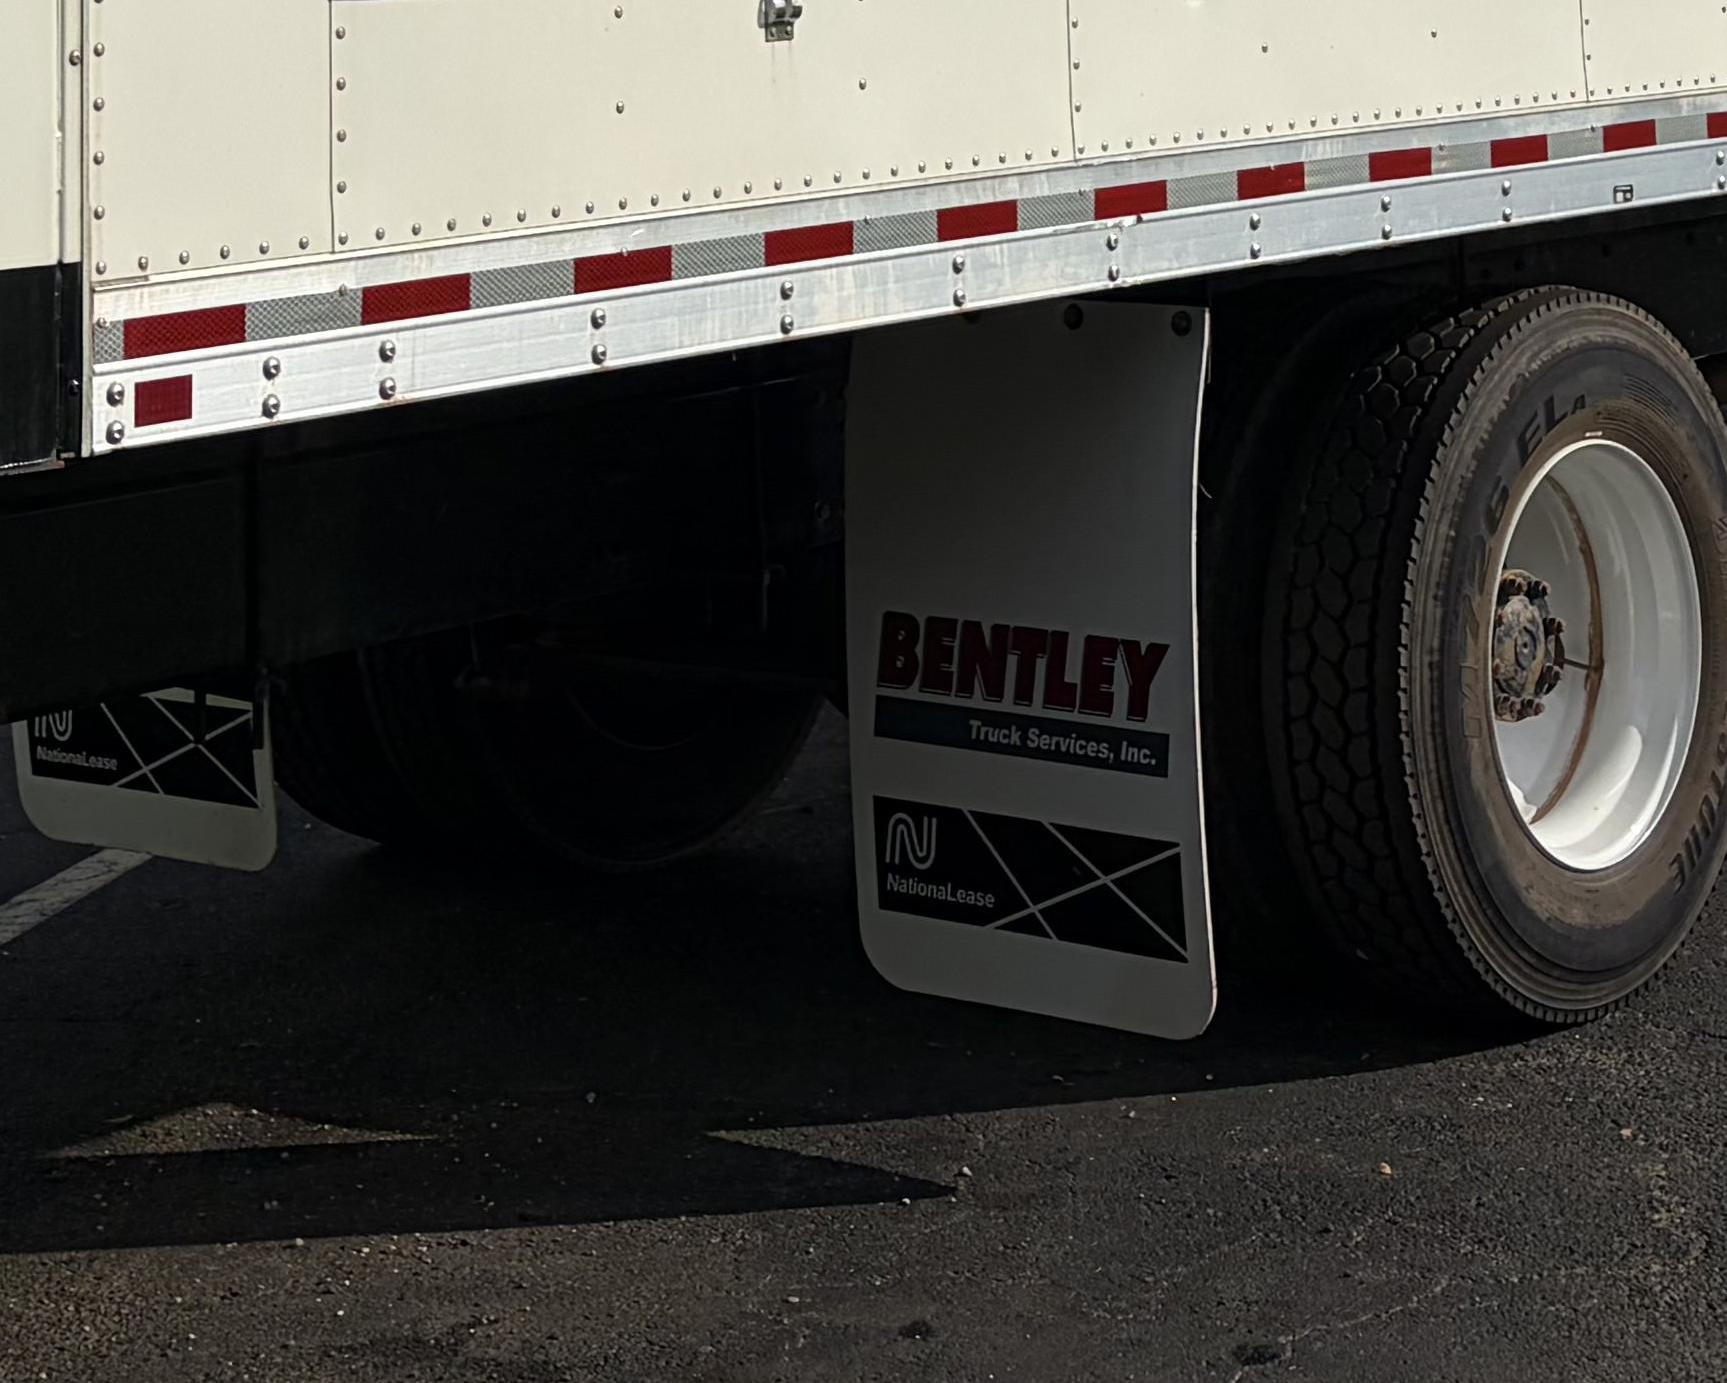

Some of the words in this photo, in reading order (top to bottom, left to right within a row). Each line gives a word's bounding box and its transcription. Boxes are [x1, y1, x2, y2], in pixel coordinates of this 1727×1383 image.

[875, 609, 1171, 723] BENTLEY
[969, 719, 1022, 747] Truck
[1026, 727, 1115, 764] Services,
[1119, 741, 1157, 766] Inc.
[886, 872, 996, 908] NationaLease
